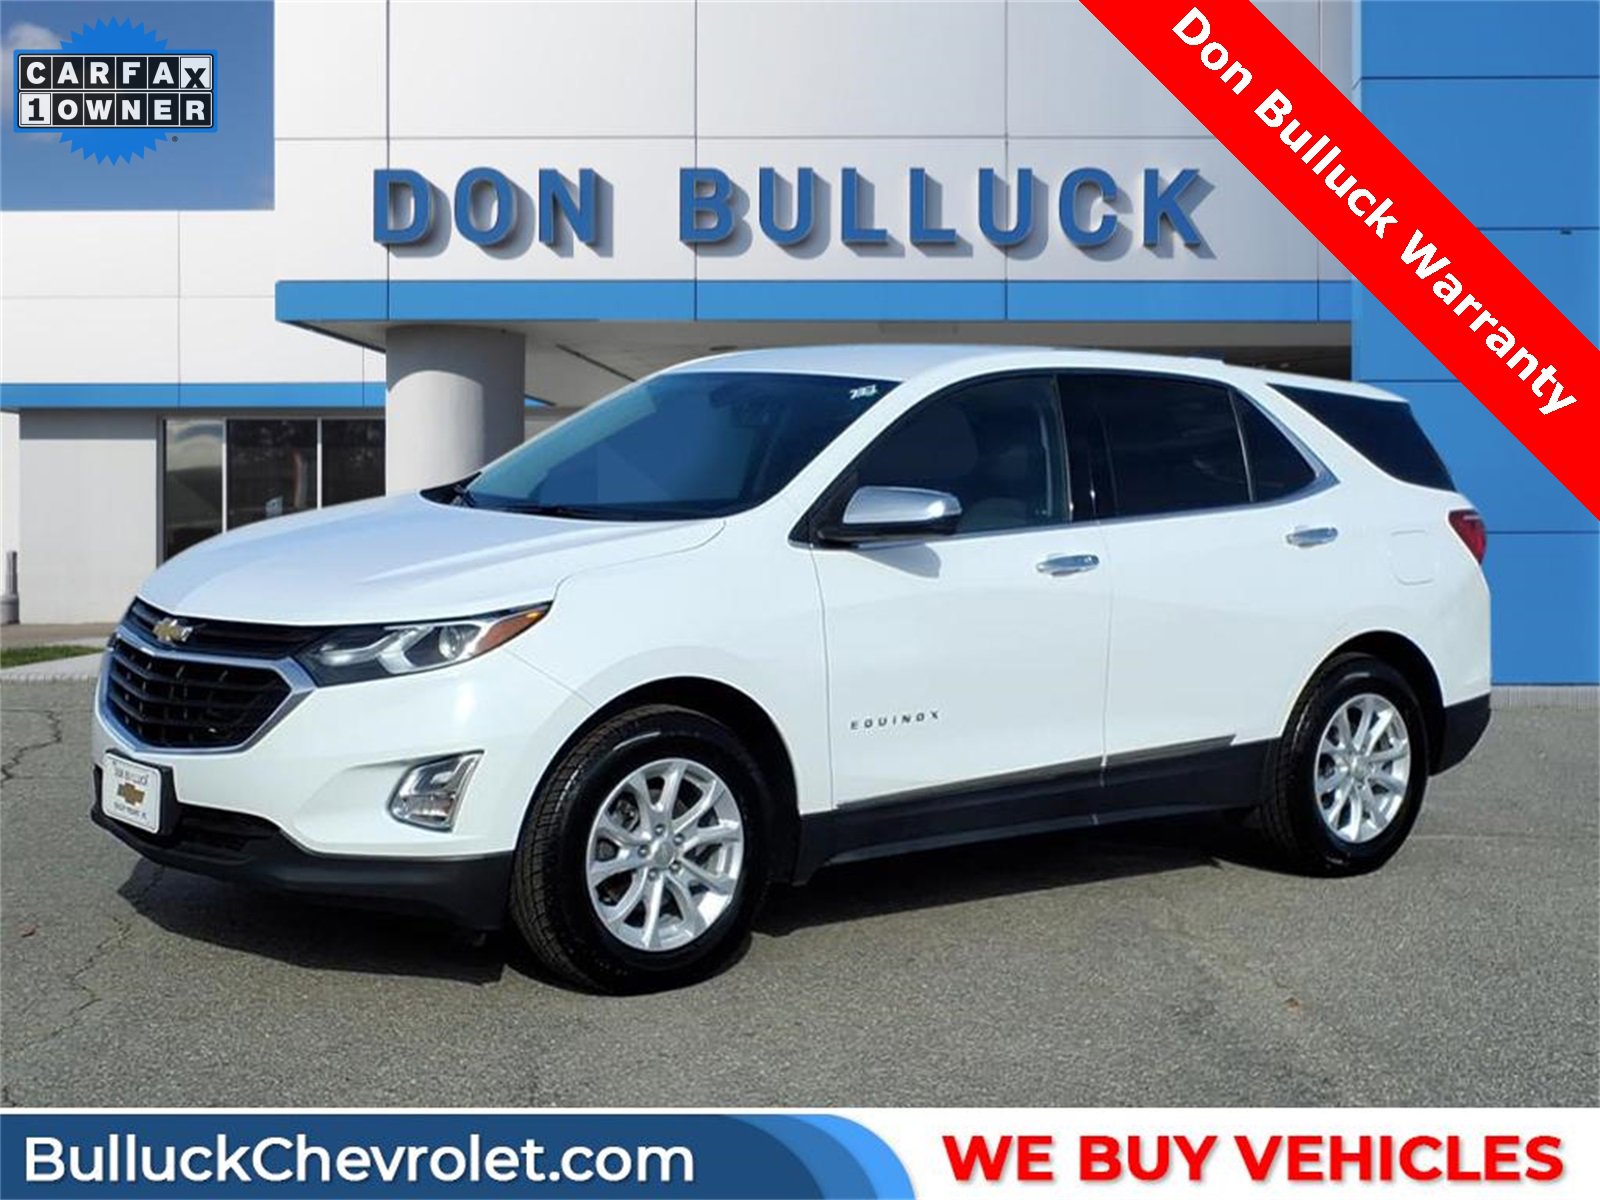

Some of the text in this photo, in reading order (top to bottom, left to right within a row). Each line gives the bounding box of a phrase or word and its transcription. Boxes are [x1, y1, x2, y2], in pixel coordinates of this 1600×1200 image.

[373, 168, 1202, 247] DON BULLUCK
[850, 709, 939, 730] EQUINOX
